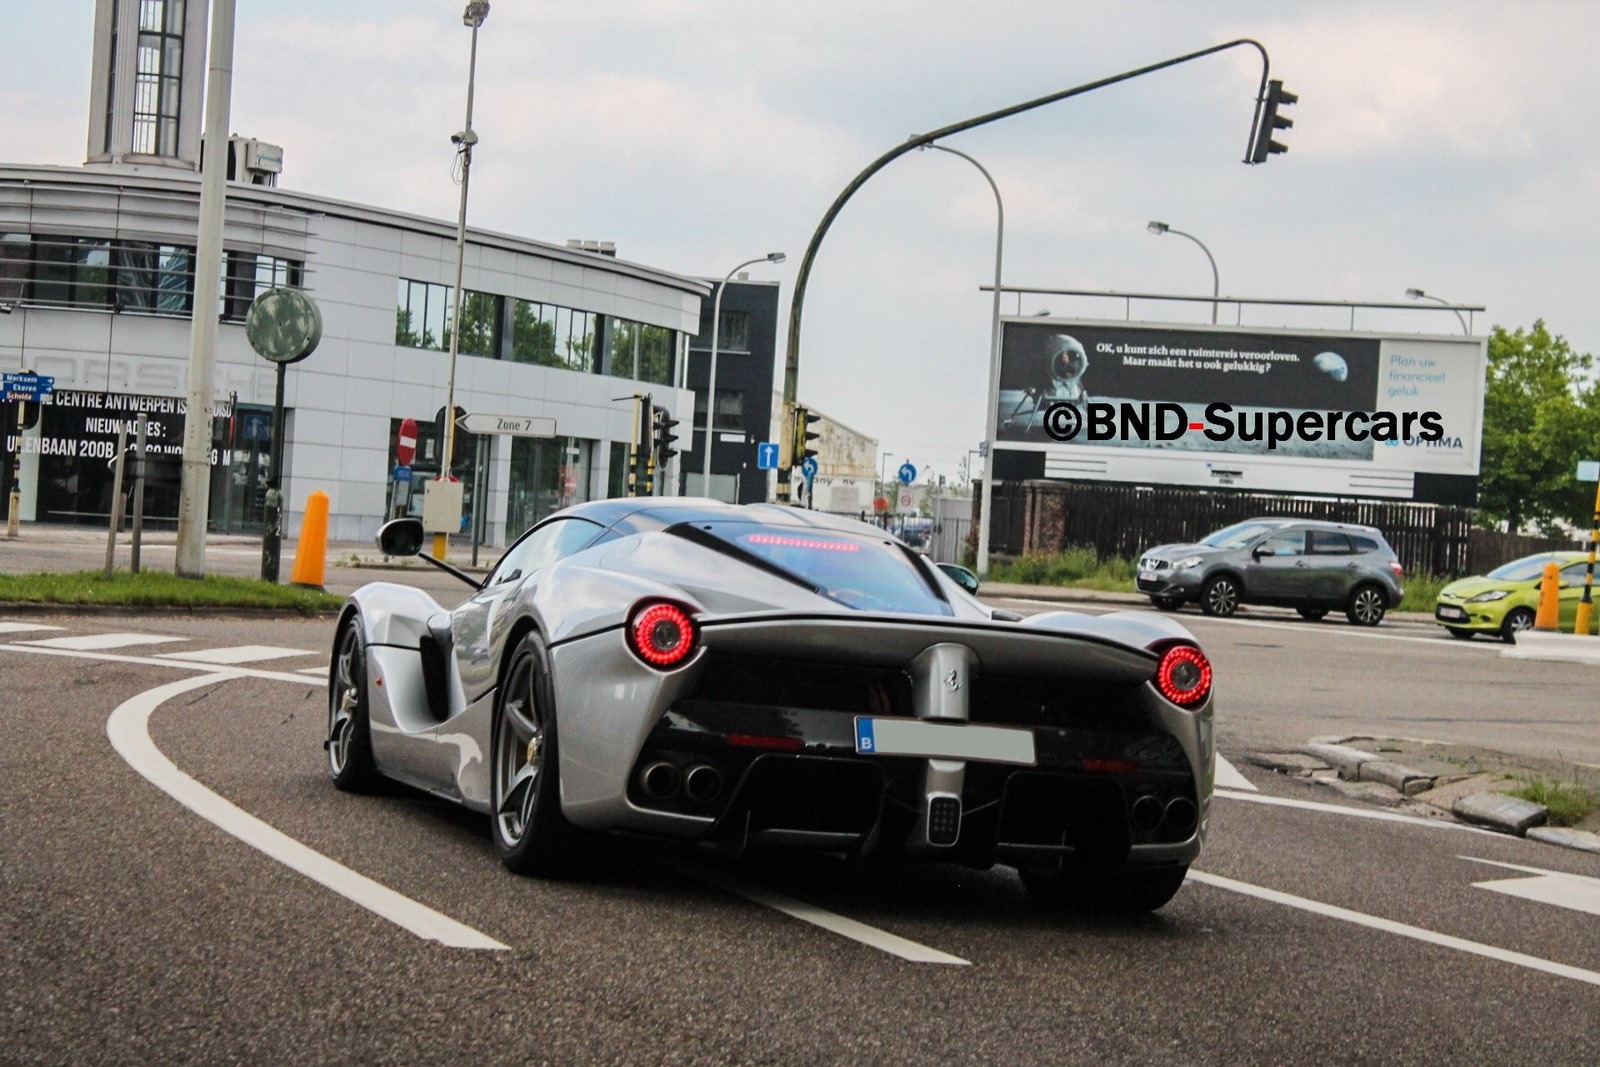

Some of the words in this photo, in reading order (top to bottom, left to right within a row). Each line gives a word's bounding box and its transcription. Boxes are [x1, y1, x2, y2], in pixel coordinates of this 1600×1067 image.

[1096, 343, 1115, 354] OK,
[1116, 345, 1122, 353] u
[1124, 344, 1147, 354] kunt
[1148, 345, 1168, 355] zich
[1169, 348, 1187, 356] een
[1188, 347, 1238, 359] ruimtereis
[1239, 350, 1300, 362] veroorloven.
[1123, 356, 1146, 366] Maar
[1147, 357, 1177, 368] maakt
[1178, 358, 1194, 369] het
[1195, 361, 1202, 369] u
[1203, 360, 1222, 370] ook
[1391, 354, 1416, 366] Plan
[1420, 359, 1437, 367] uw
[1389, 370, 1446, 383] financieel
[1388, 386, 1419, 397] geluk
[56, 390, 103, 409] CENTRE
[104, 394, 174, 414] ANTWERPEN
[176, 398, 187, 415] IS
[86, 417, 122, 434] NIEUW
[126, 420, 161, 437] ADES
[496, 419, 521, 431] Zone
[525, 420, 532, 431] 7
[80, 440, 114, 459] 200B
[861, 737, 872, 750] B
